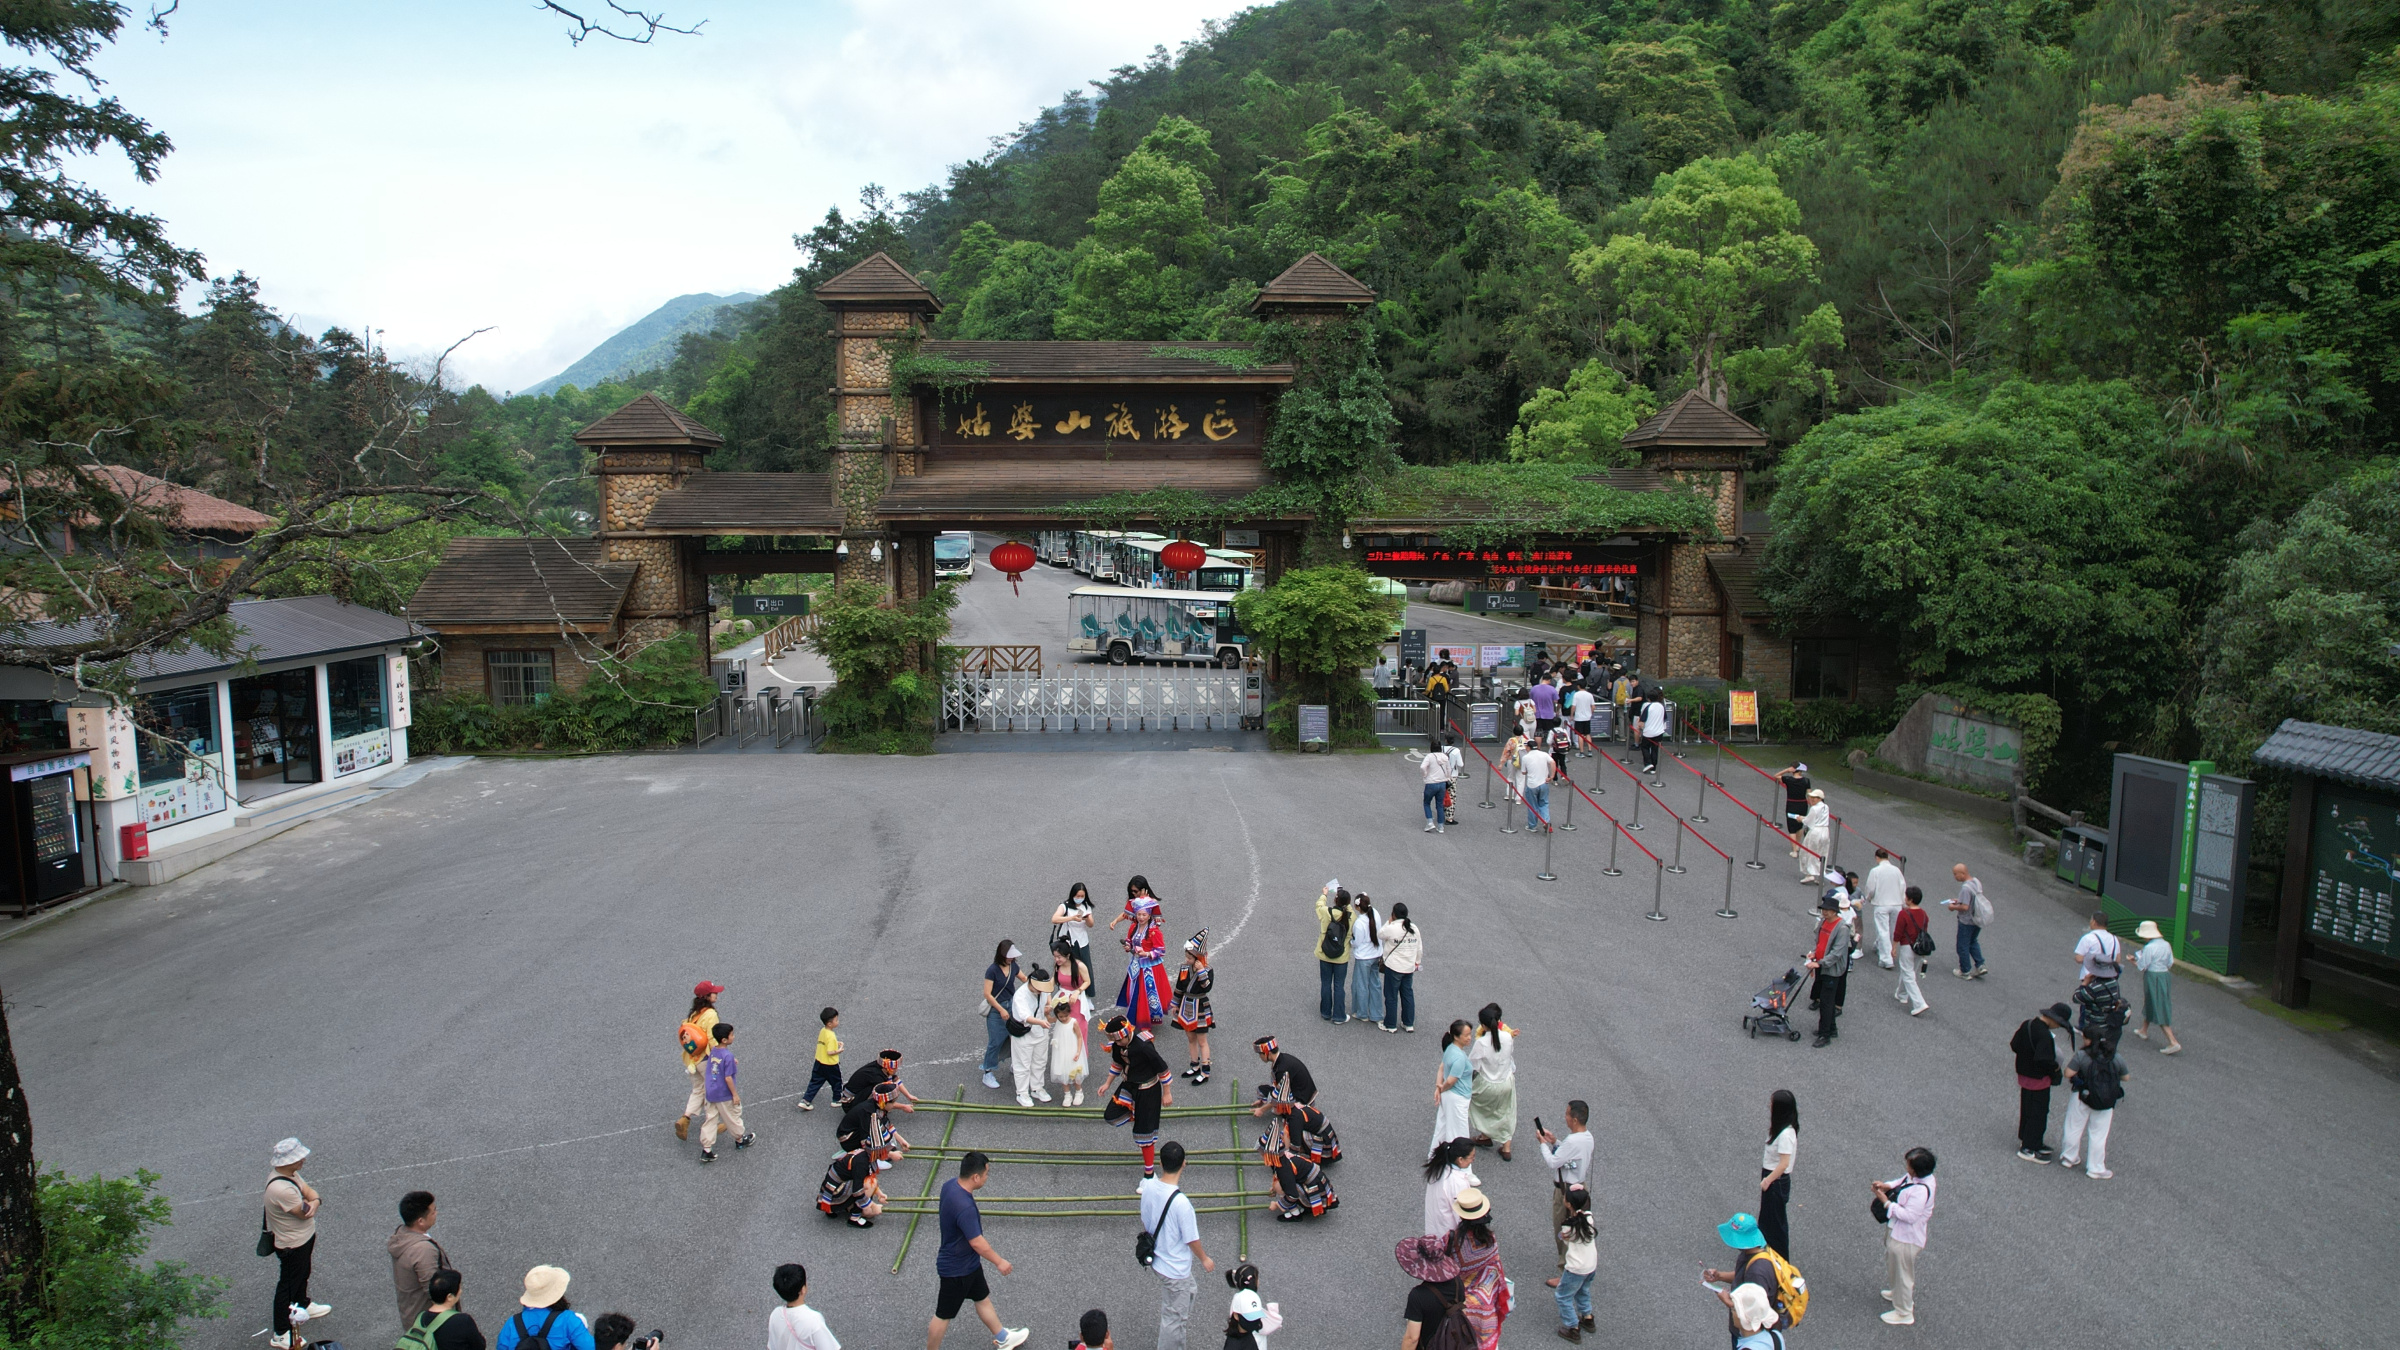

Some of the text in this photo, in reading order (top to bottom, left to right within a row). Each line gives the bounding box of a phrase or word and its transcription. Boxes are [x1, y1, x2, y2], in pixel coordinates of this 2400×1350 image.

[956, 399, 1238, 441] 姑婆山旅游区
[770, 599, 784, 607] 出口
[27, 756, 76, 775] 自助售货机
